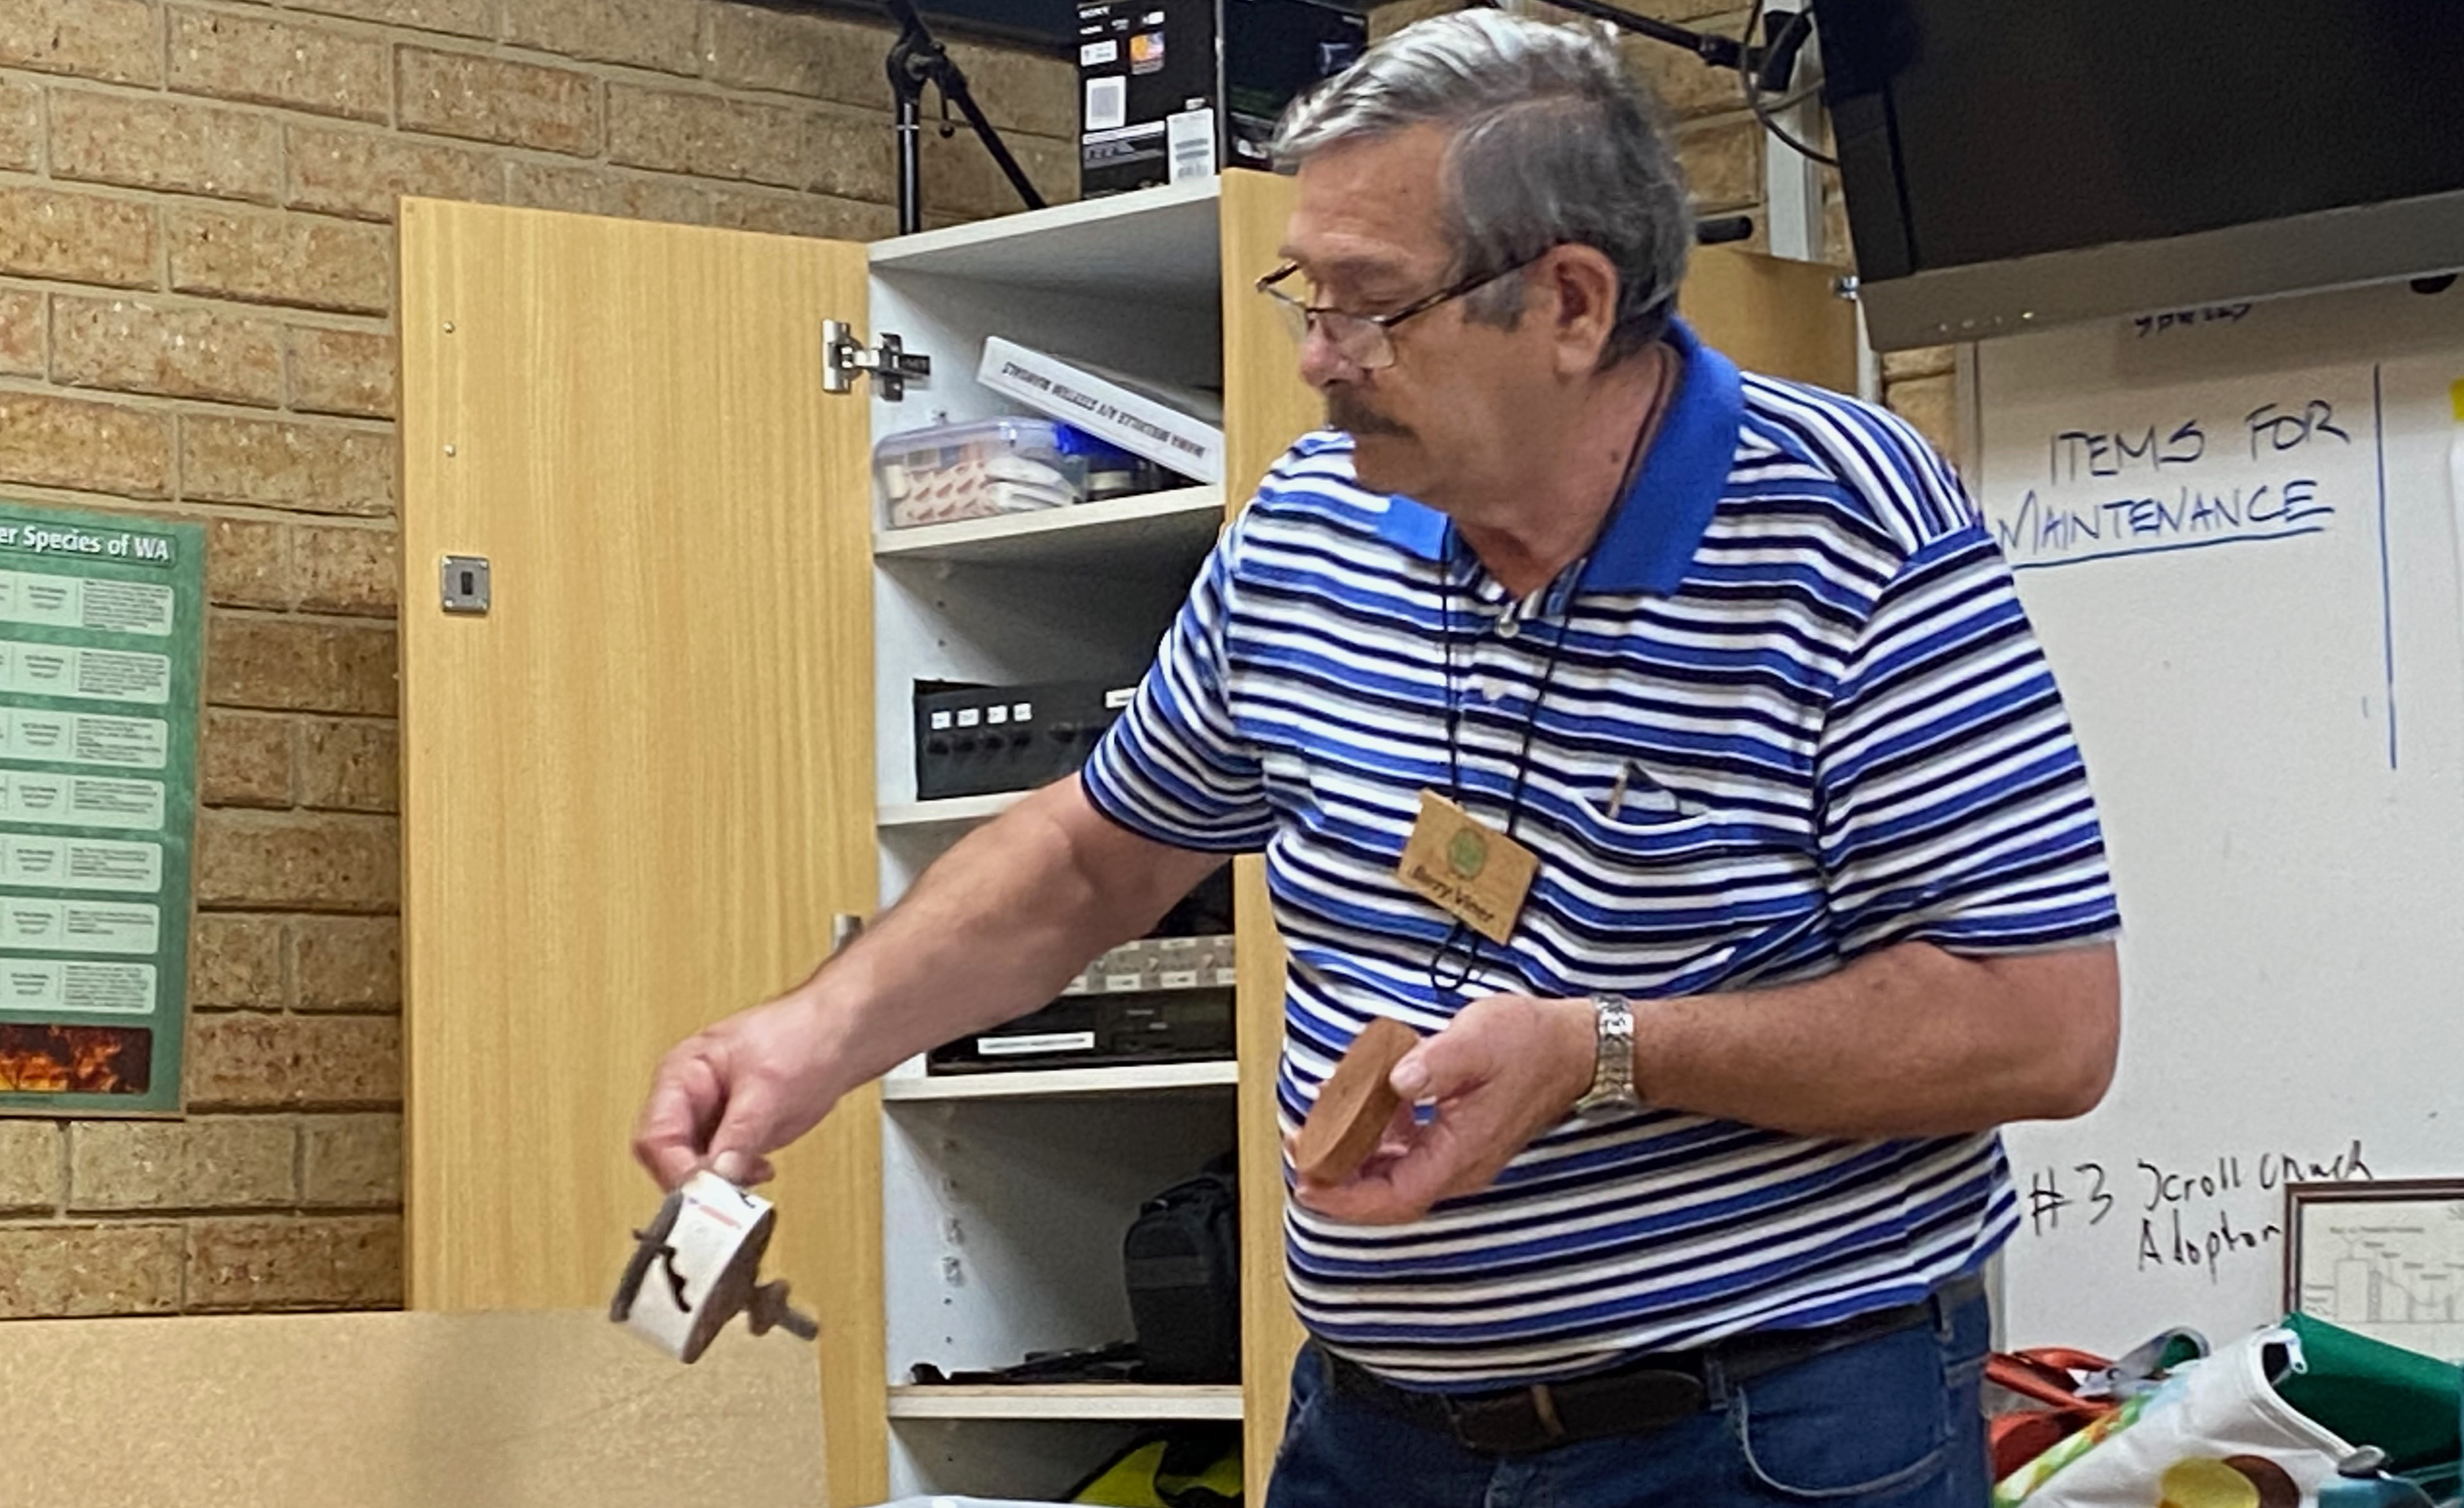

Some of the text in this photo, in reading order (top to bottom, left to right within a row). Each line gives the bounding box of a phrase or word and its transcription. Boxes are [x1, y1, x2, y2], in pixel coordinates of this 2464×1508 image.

[2051, 399, 2351, 485] ITEMS FOR
[23, 525, 101, 552] Species
[108, 534, 130, 556] of
[134, 537, 169, 560] WA
[1998, 480, 2334, 555] MAINTENANCE
[2138, 1156, 2241, 1211] Scroll
